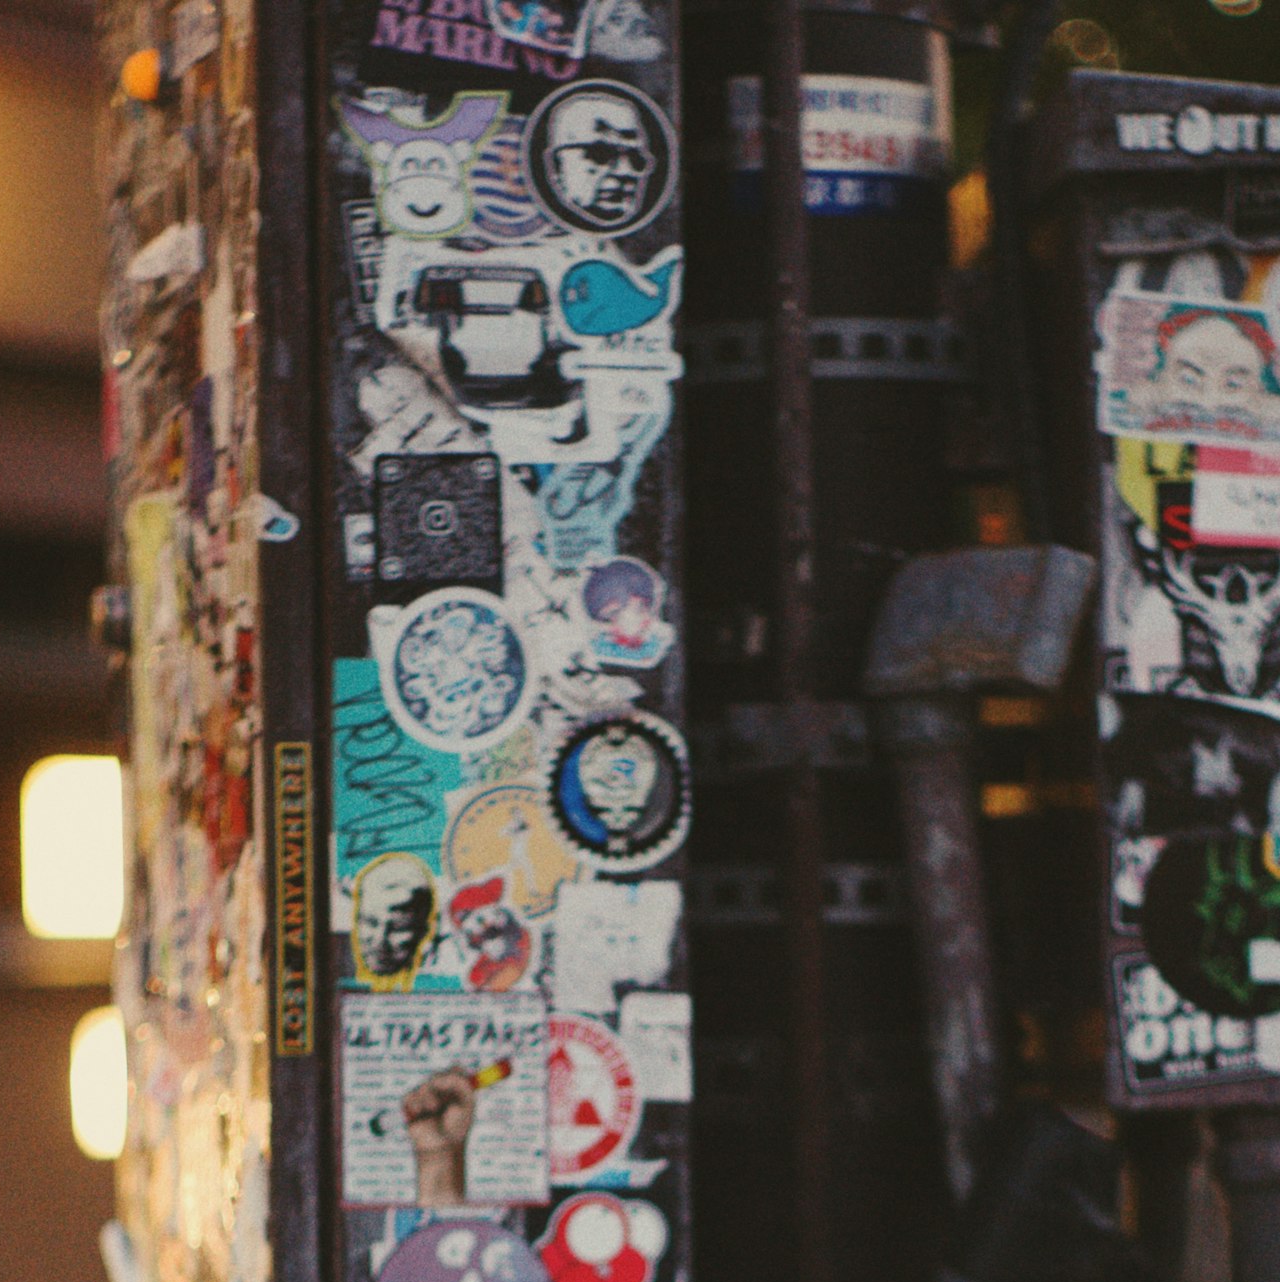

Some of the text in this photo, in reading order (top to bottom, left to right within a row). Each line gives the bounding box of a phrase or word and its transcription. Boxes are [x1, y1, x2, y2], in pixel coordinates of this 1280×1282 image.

[282, 753, 307, 1048] LOST ANYWHERE
[343, 1021, 452, 1049] ULTRAS
